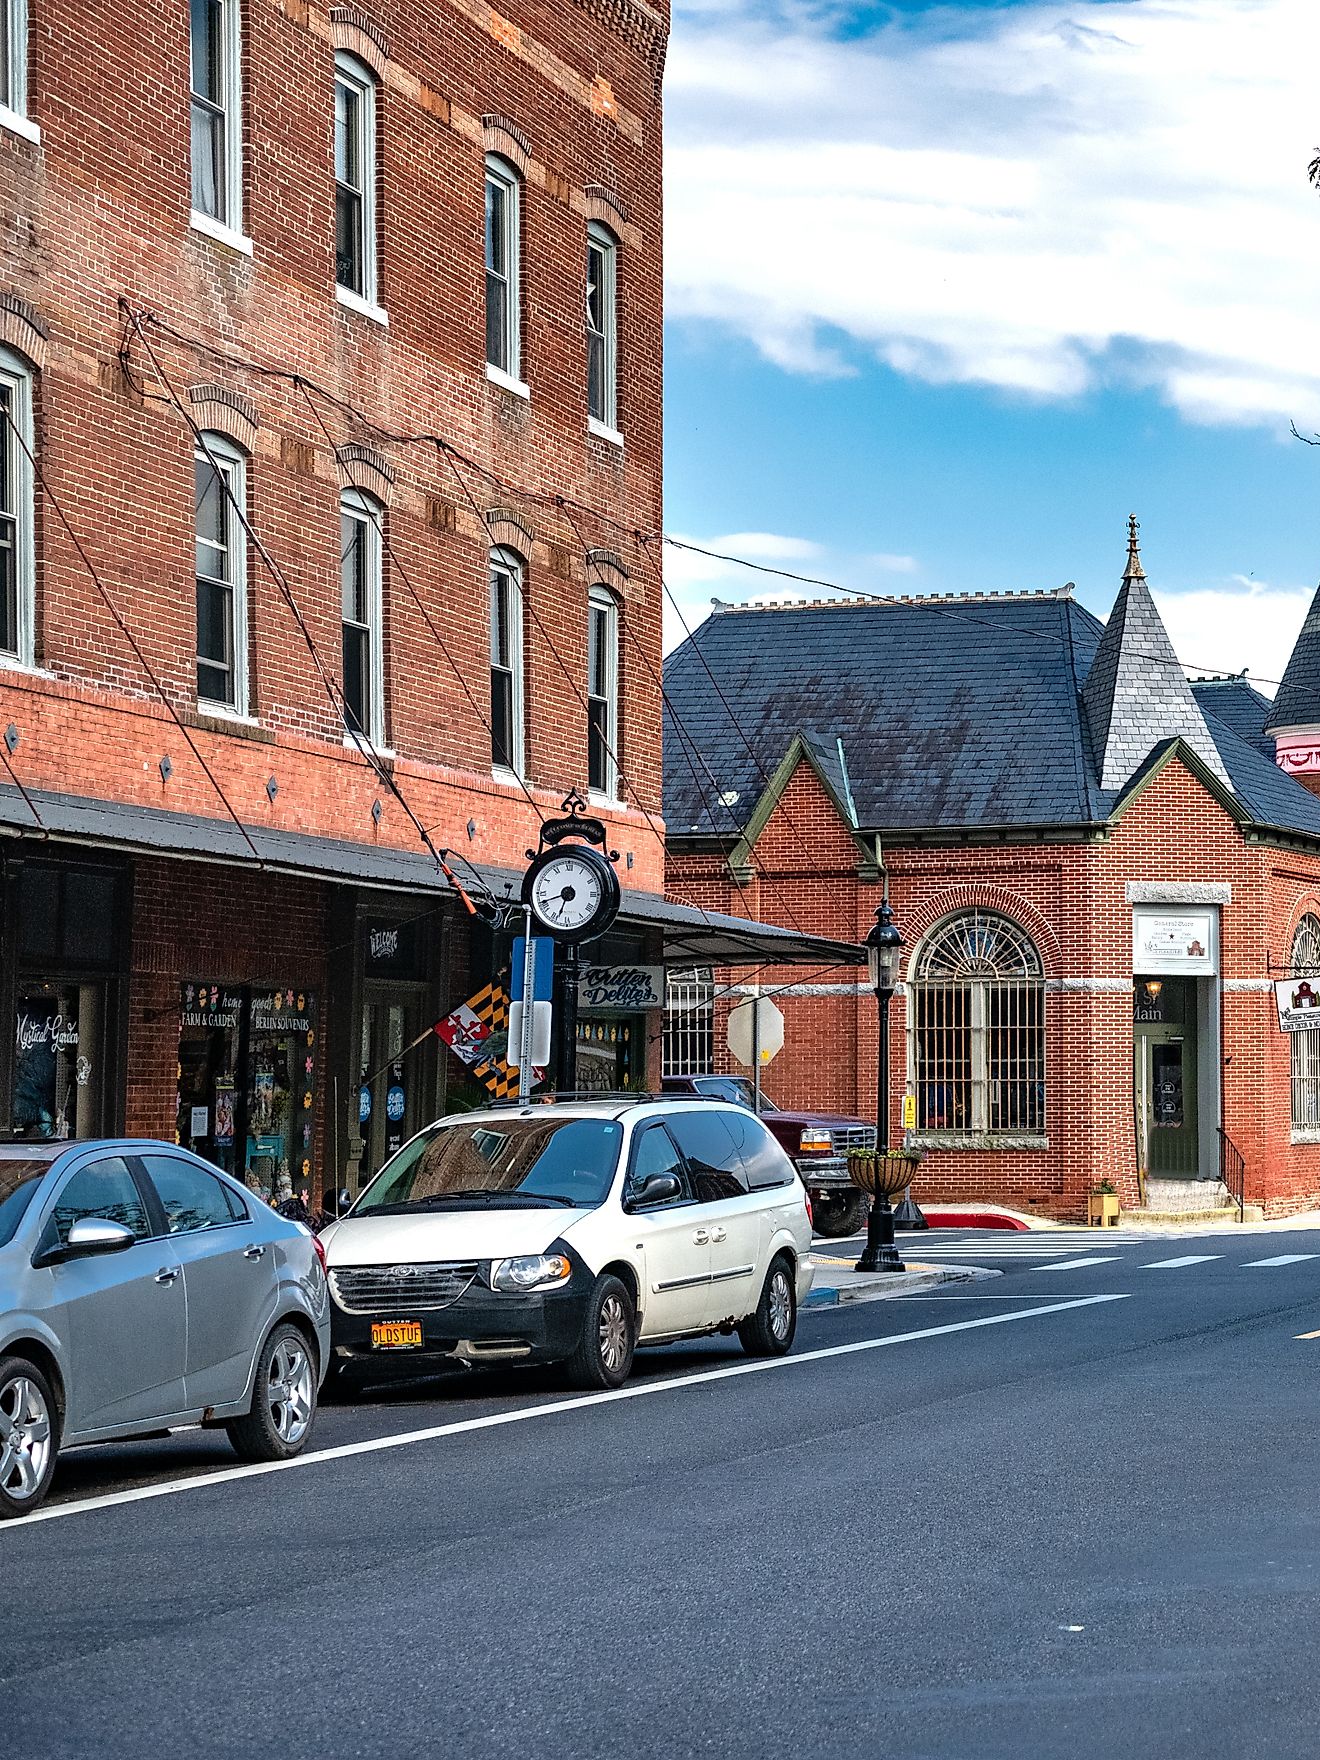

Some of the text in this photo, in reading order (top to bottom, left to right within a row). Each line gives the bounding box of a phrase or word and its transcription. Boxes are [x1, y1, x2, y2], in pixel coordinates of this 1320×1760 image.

[222, 991, 243, 1008] home
[181, 1012, 237, 1028] FARM & GARDEN
[255, 1017, 310, 1032] BERLIN SOUVENIRS
[16, 1013, 79, 1053] Mystical Garden
[372, 1327, 421, 1343] OLDSTUF
